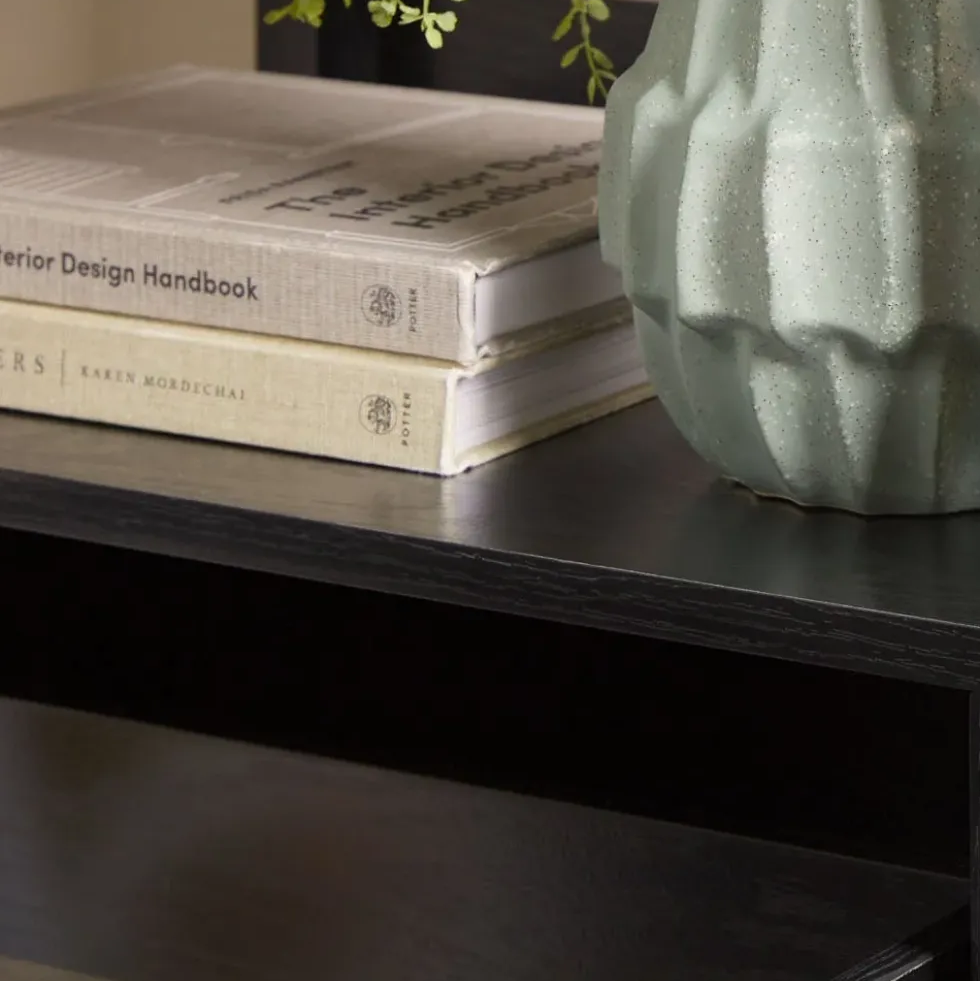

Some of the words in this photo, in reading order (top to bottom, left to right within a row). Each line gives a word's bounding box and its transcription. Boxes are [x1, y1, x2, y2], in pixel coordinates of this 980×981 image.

[264, 185, 368, 212] The
[0, 244, 55, 272] erior
[61, 251, 136, 288] Design
[142, 262, 260, 301] Handbook
[408, 287, 418, 333] POTTER
[80, 365, 136, 385] KAREN
[142, 374, 246, 401] MORDECHAI
[401, 392, 412, 447] POTTER
